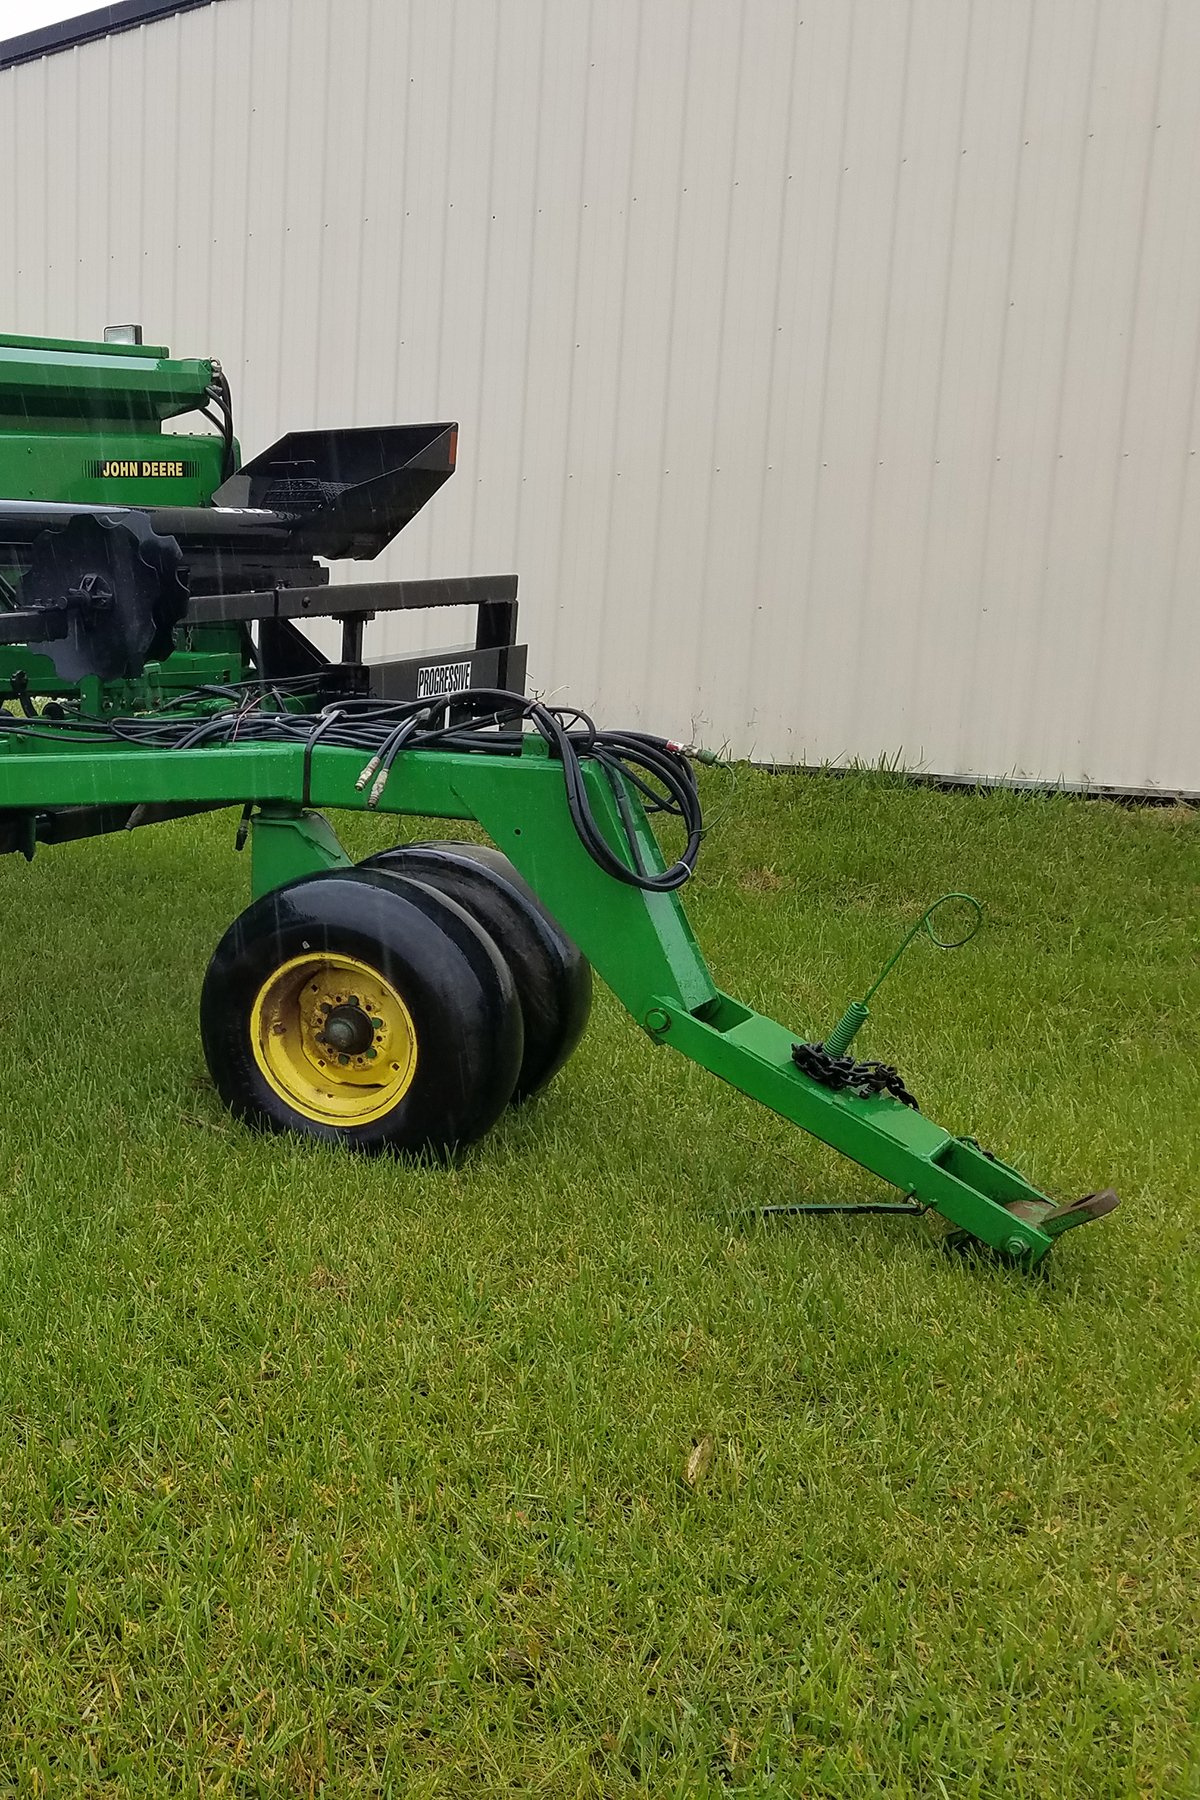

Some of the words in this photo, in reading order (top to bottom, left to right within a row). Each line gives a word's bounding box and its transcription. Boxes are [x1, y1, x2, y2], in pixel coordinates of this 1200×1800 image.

[103, 462, 138, 477] JOHN
[142, 462, 183, 477] DEERE
[418, 663, 470, 697] PROGRESSIVE
